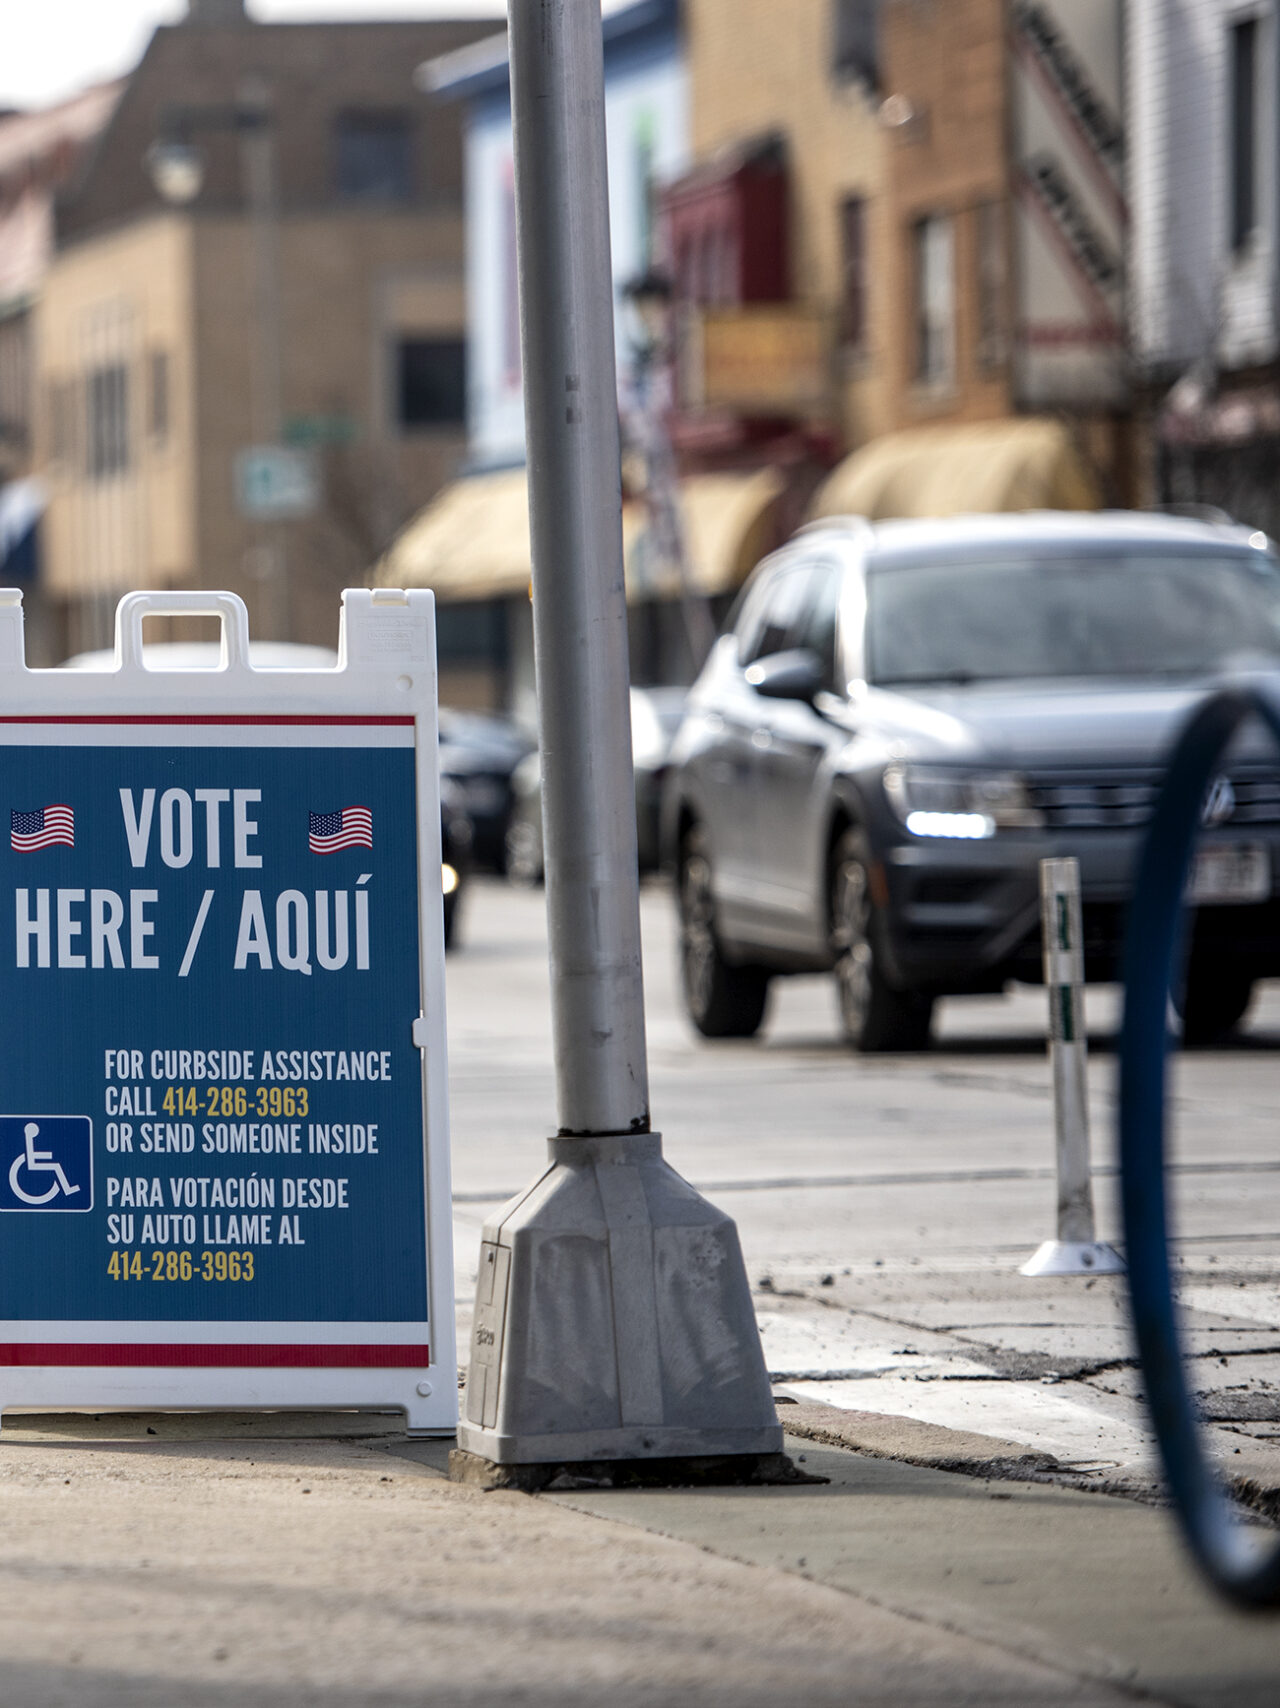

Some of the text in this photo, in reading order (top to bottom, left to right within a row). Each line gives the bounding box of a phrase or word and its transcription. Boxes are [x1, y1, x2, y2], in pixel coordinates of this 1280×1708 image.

[120, 788, 263, 868] VOTE
[15, 873, 373, 977] HERE / AQUÍ
[105, 1049, 392, 1081] FOR CURBSIDE ASSISTANCE
[105, 1086, 309, 1117] CALL 414-286-3963
[106, 1122, 379, 1154] OR SEND SOMEONE INSIDE
[107, 1172, 349, 1208] PARA VOTACIÓN DESDE
[107, 1213, 305, 1245] SU AUTO LLAME AL
[107, 1250, 254, 1281] 414-286-3963
